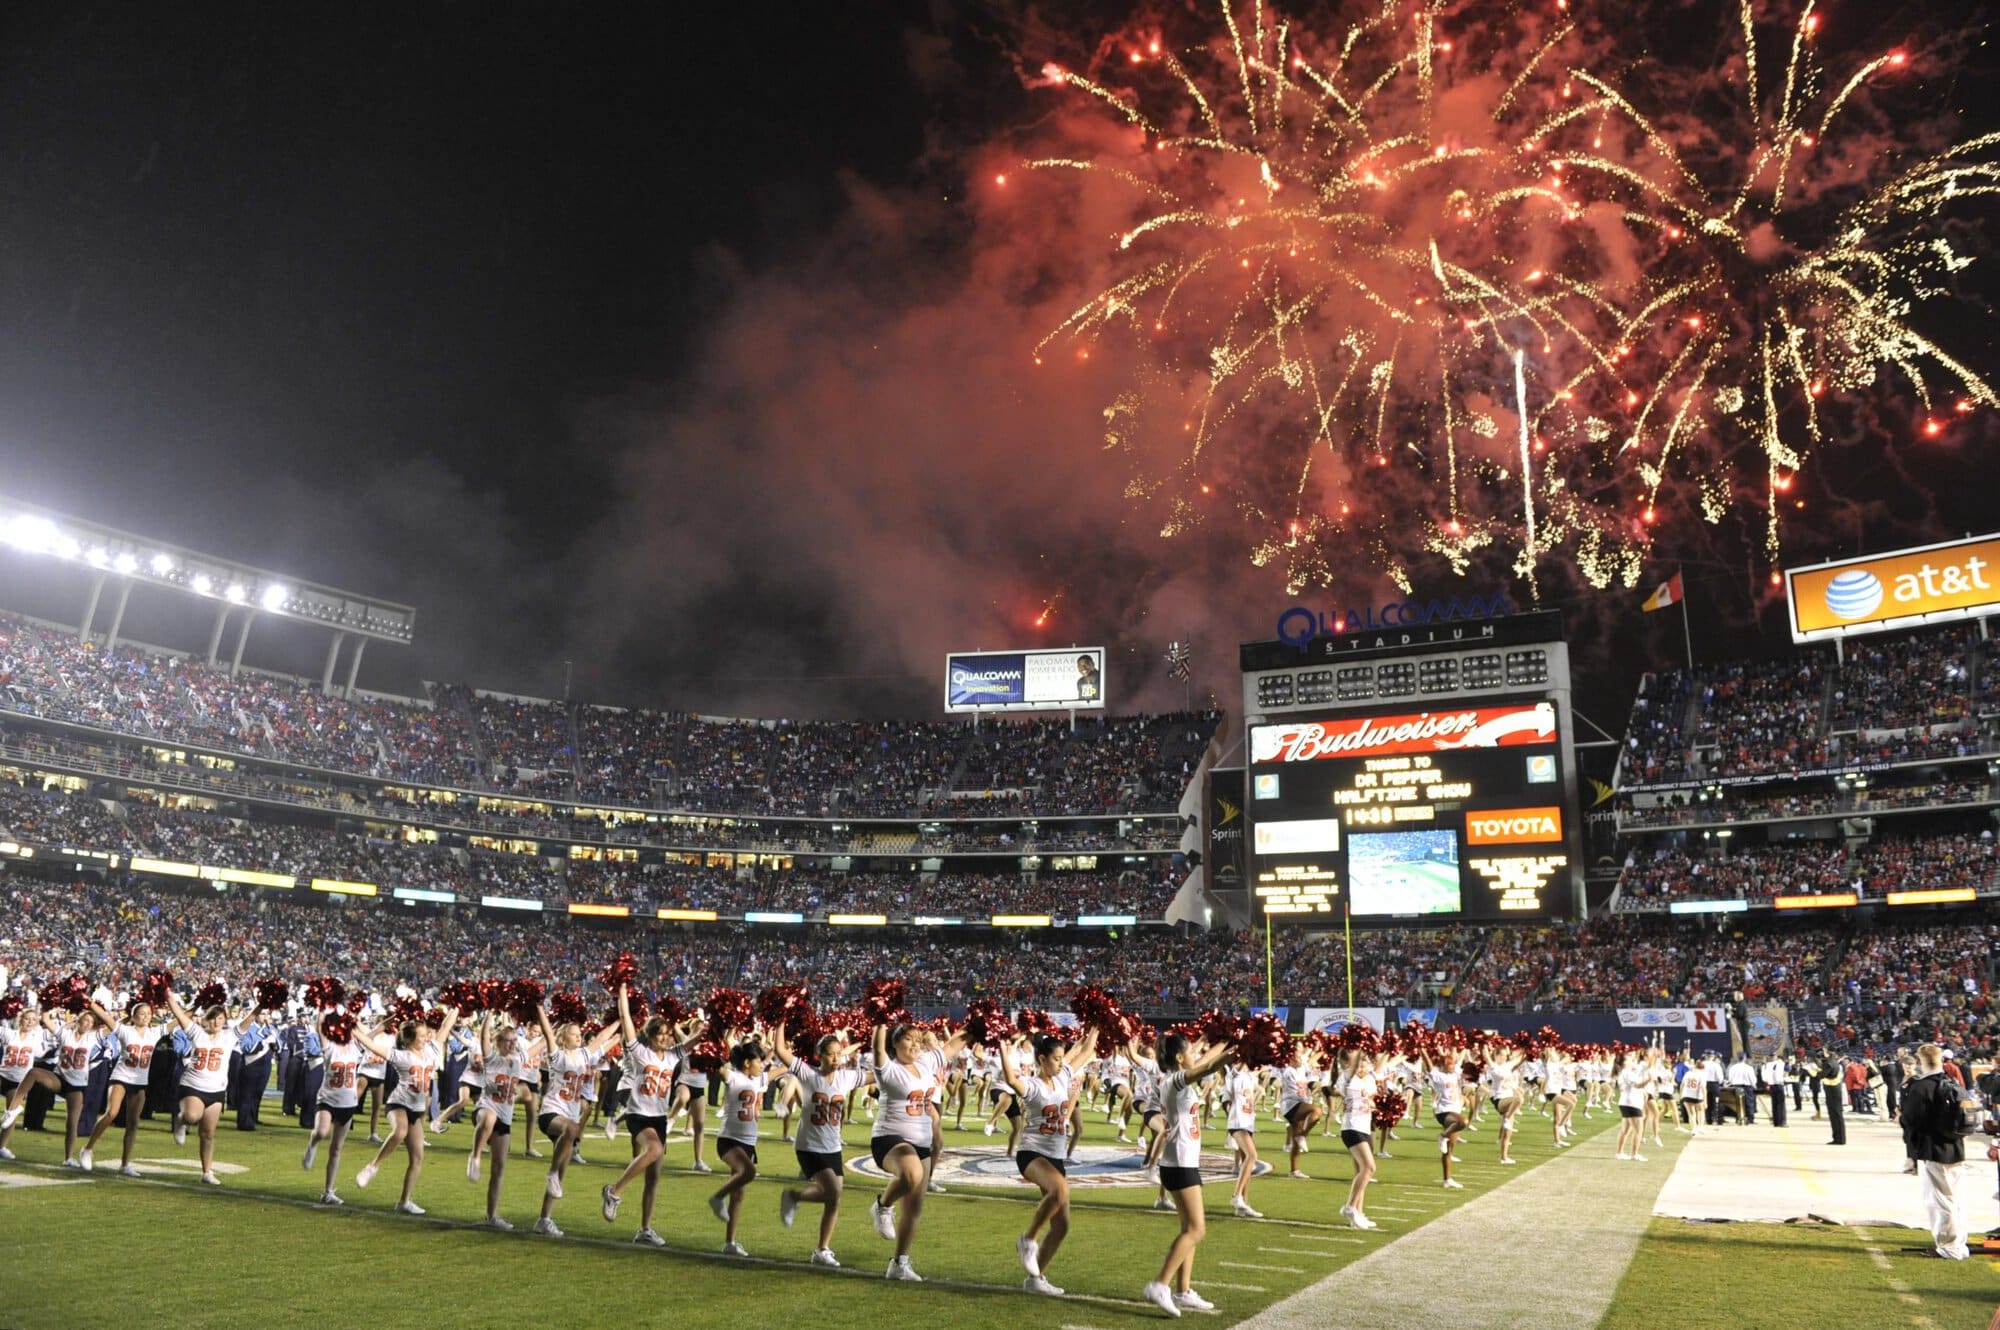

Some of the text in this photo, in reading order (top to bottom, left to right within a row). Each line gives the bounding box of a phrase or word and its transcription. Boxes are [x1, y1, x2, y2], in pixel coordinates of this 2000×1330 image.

[1893, 556, 1991, 602] at&t
[1277, 592, 1513, 652] QUALCOMM
[1325, 625, 1495, 653] STADIUM
[1028, 656, 1076, 667] PALOMAR
[952, 670, 1021, 686] QUALCOMM
[1278, 712, 1478, 762] Budweiser
[1414, 756, 1431, 768] TO
[1797, 769, 1827, 777] OCATION
[1355, 769, 1442, 787] DR PEPPER
[1426, 783, 1472, 799] SHOW
[1211, 829, 1242, 841] Sprint
[1470, 817, 1557, 837] TOYOTA
[1324, 1014, 1350, 1024] PACIFIC
[1694, 1010, 1718, 1031] N
[5, 1046, 32, 1068] 36
[61, 1046, 87, 1069] 36
[126, 1044, 153, 1068] 36
[193, 1047, 224, 1071] 36
[330, 1061, 355, 1088] 36
[640, 1065, 673, 1098] 36
[811, 1092, 844, 1126] 36
